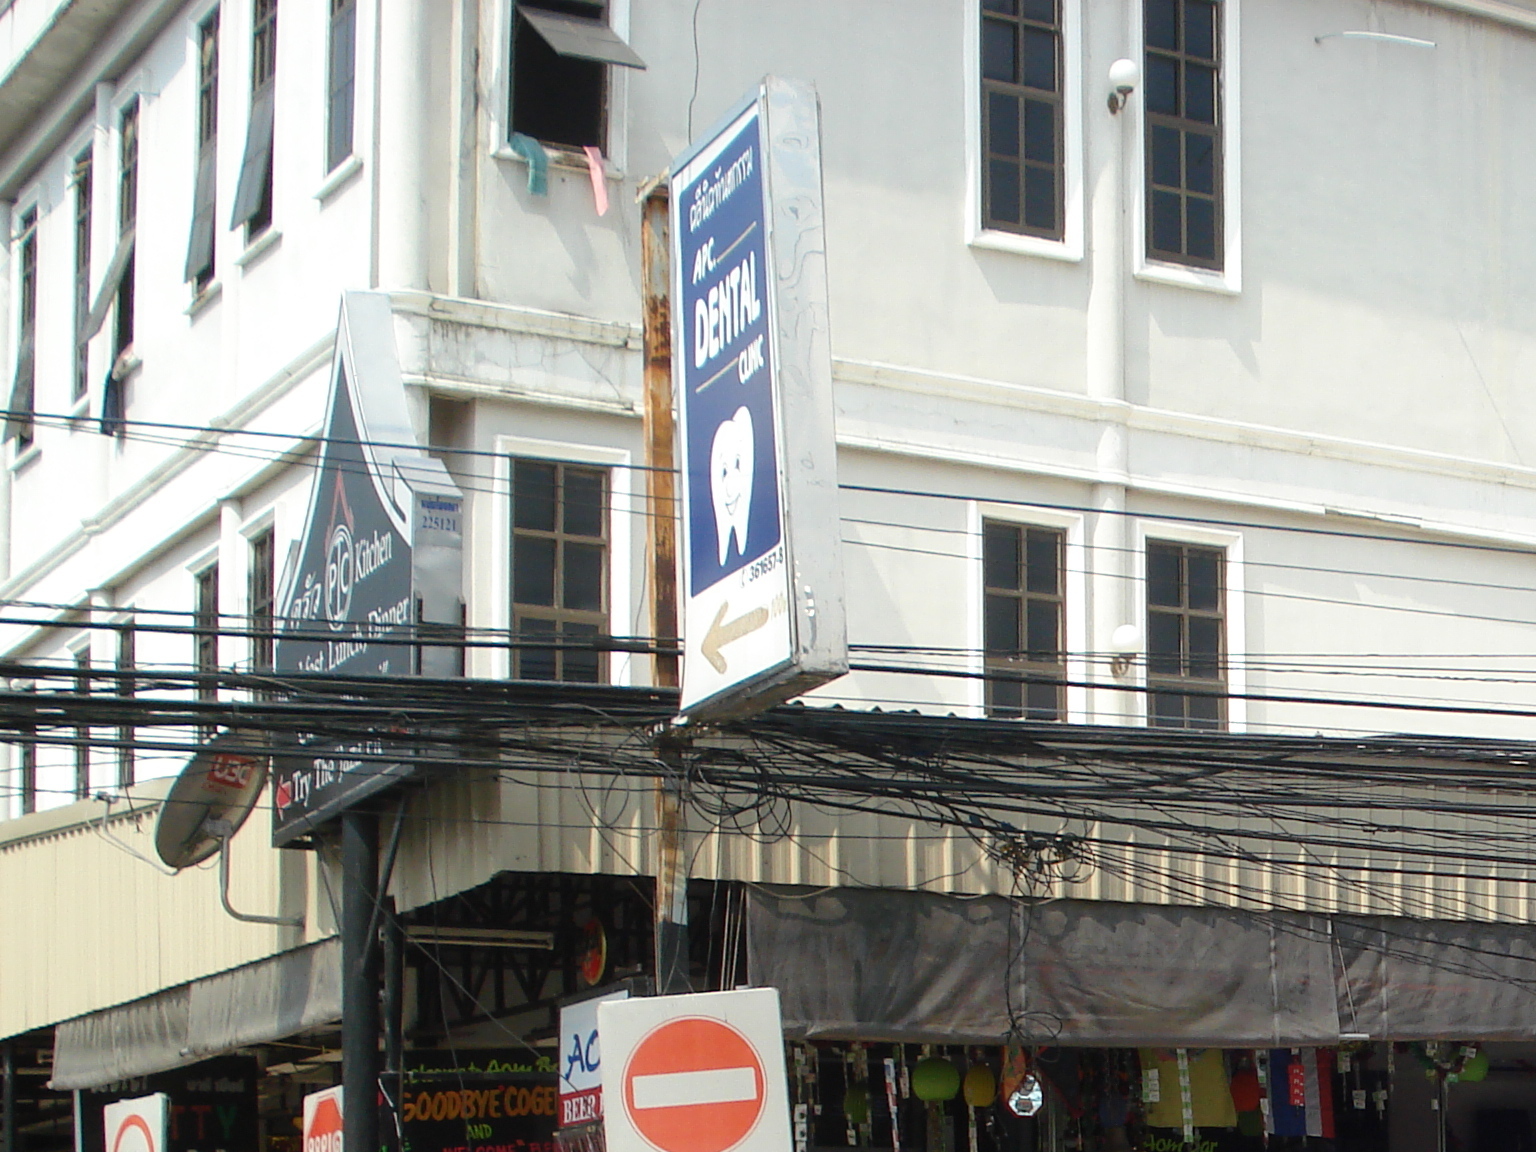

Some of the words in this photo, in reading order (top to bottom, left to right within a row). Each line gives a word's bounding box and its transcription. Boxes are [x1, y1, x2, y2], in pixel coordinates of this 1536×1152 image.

[695, 250, 760, 368] DENTAL
[738, 333, 764, 384] CLINIC
[422, 515, 456, 532] 225121
[355, 529, 392, 583] Kitchen
[293, 770, 312, 807] Try
[314, 758, 335, 789] The
[466, 1123, 495, 1141] AND
[564, 1094, 597, 1124] BEER
